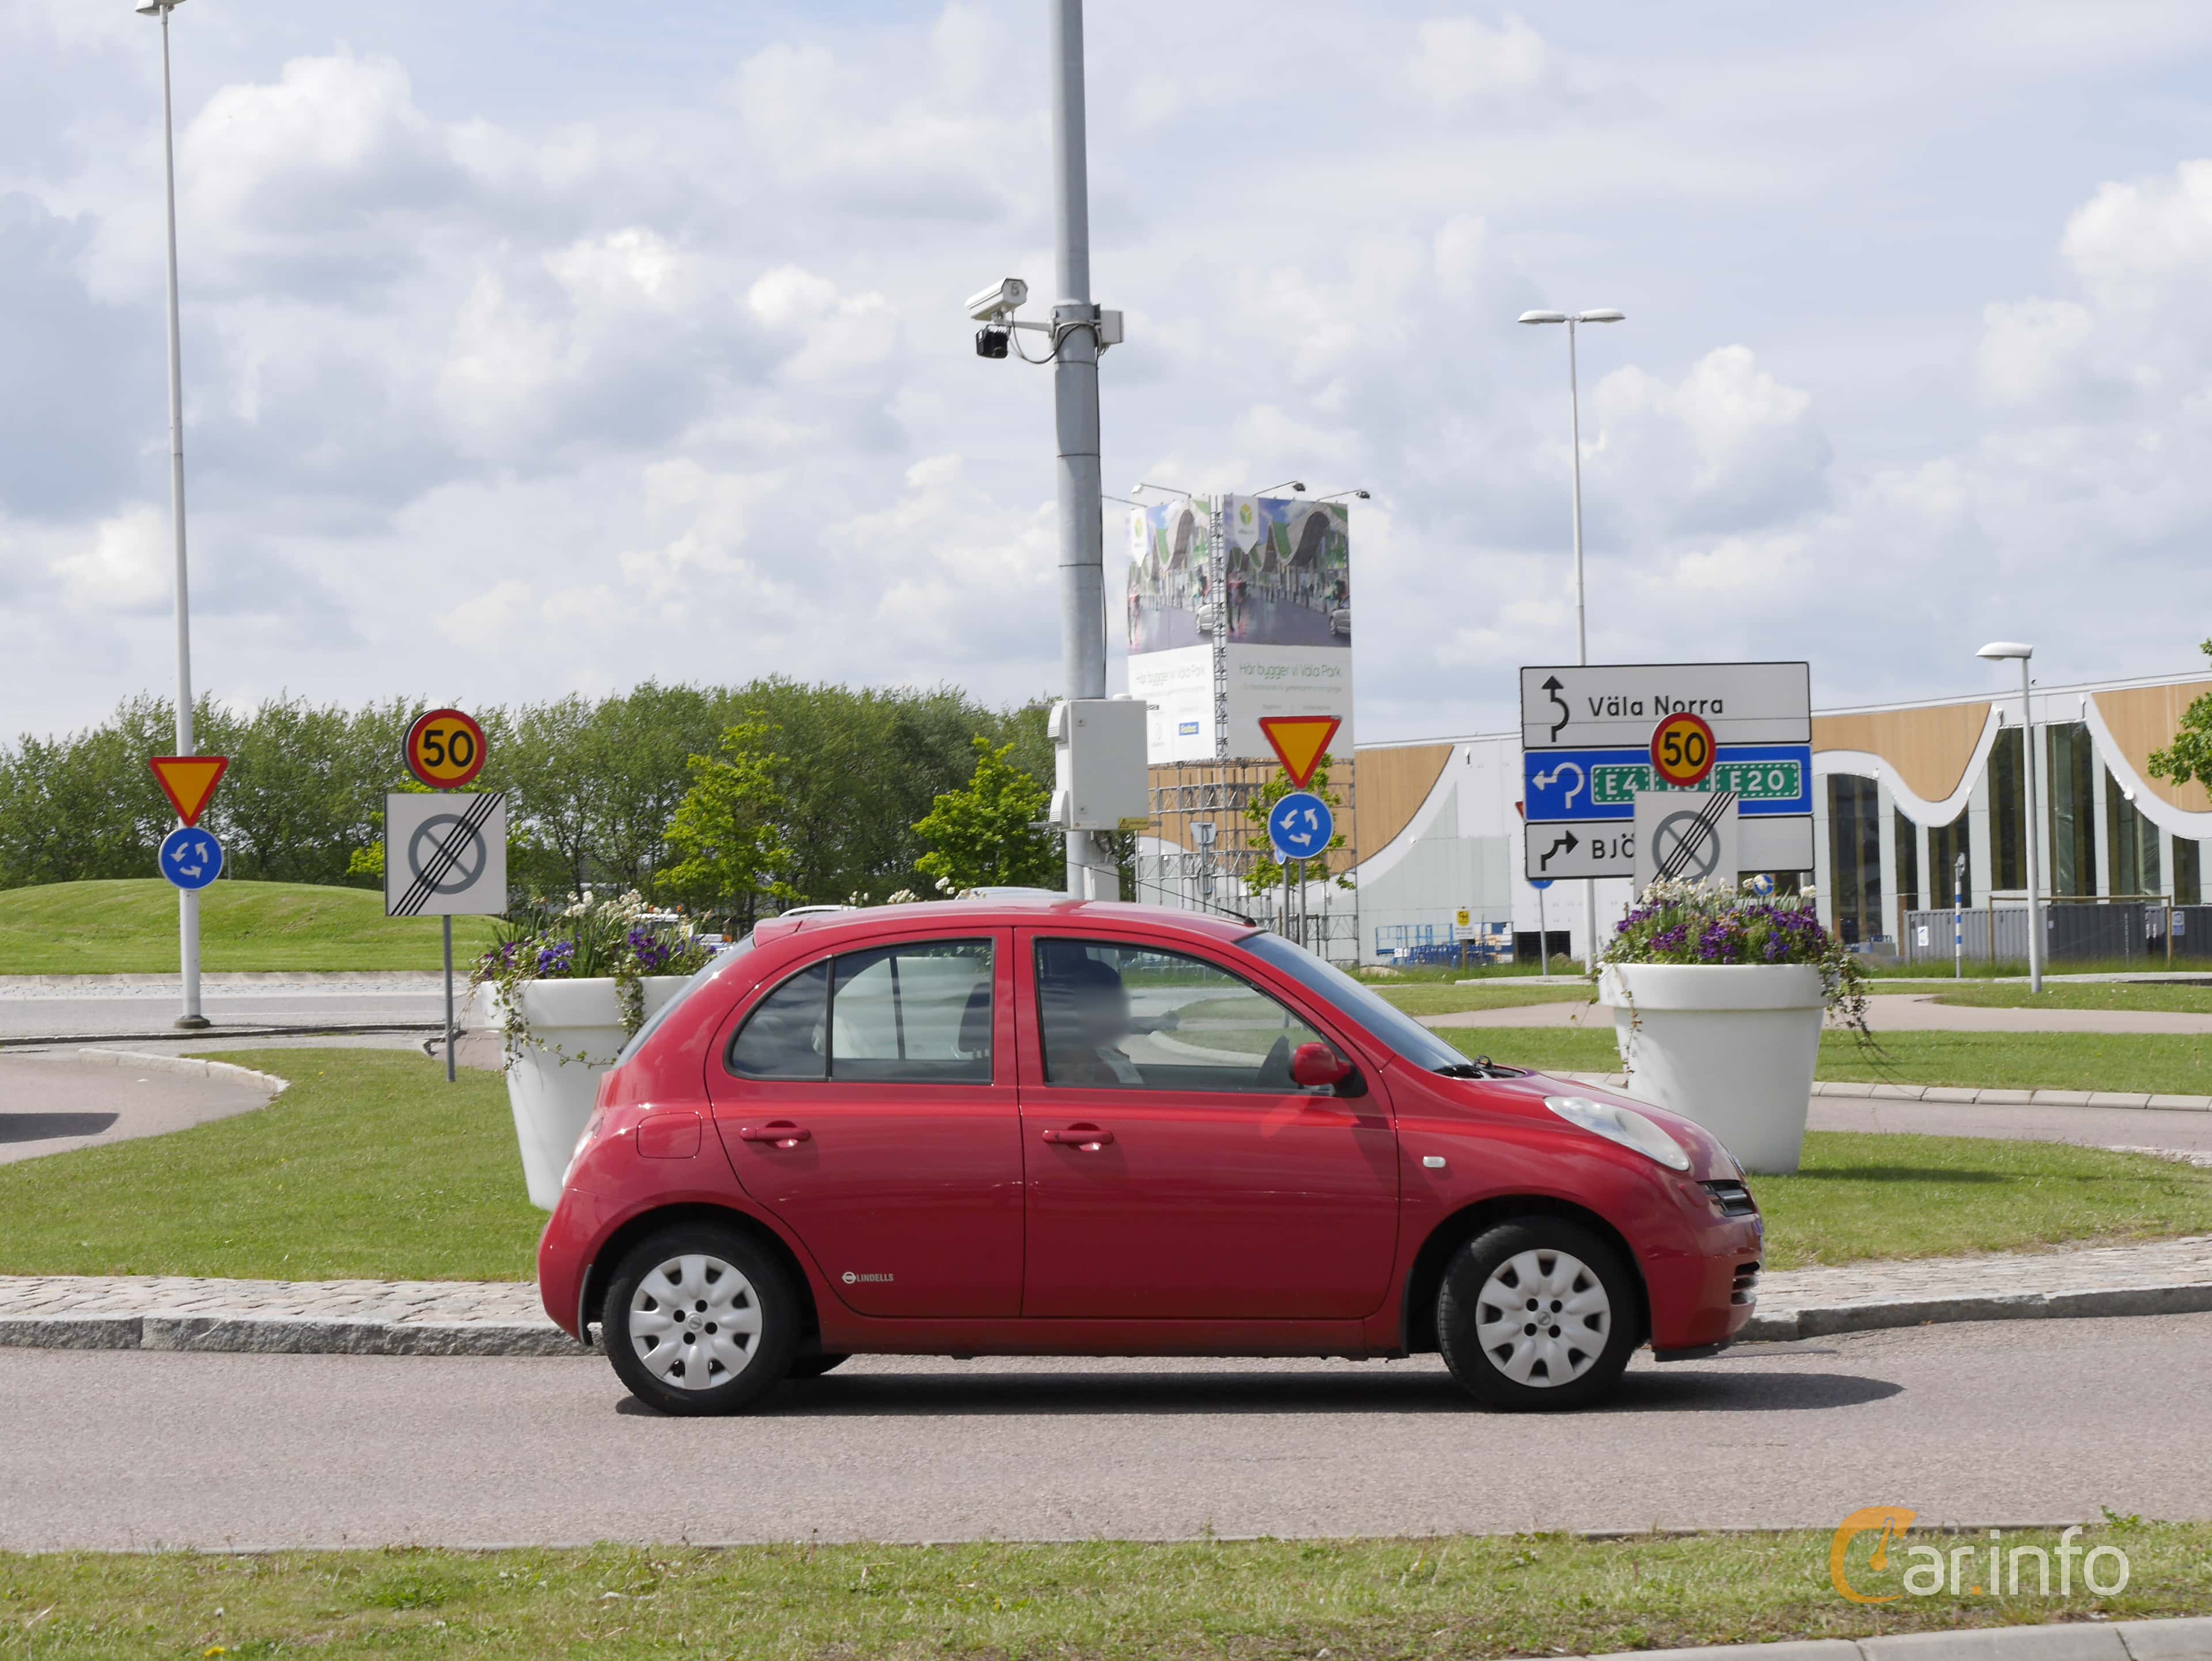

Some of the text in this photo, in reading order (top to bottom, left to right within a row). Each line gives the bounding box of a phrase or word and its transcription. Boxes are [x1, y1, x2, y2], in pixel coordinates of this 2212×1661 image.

[1588, 695, 1724, 717] Väla Norra
[423, 729, 474, 767] 50
[1663, 731, 1706, 767] 50
[1605, 769, 1785, 795] E4 E20
[857, 1273, 895, 1282] LINDELLS
